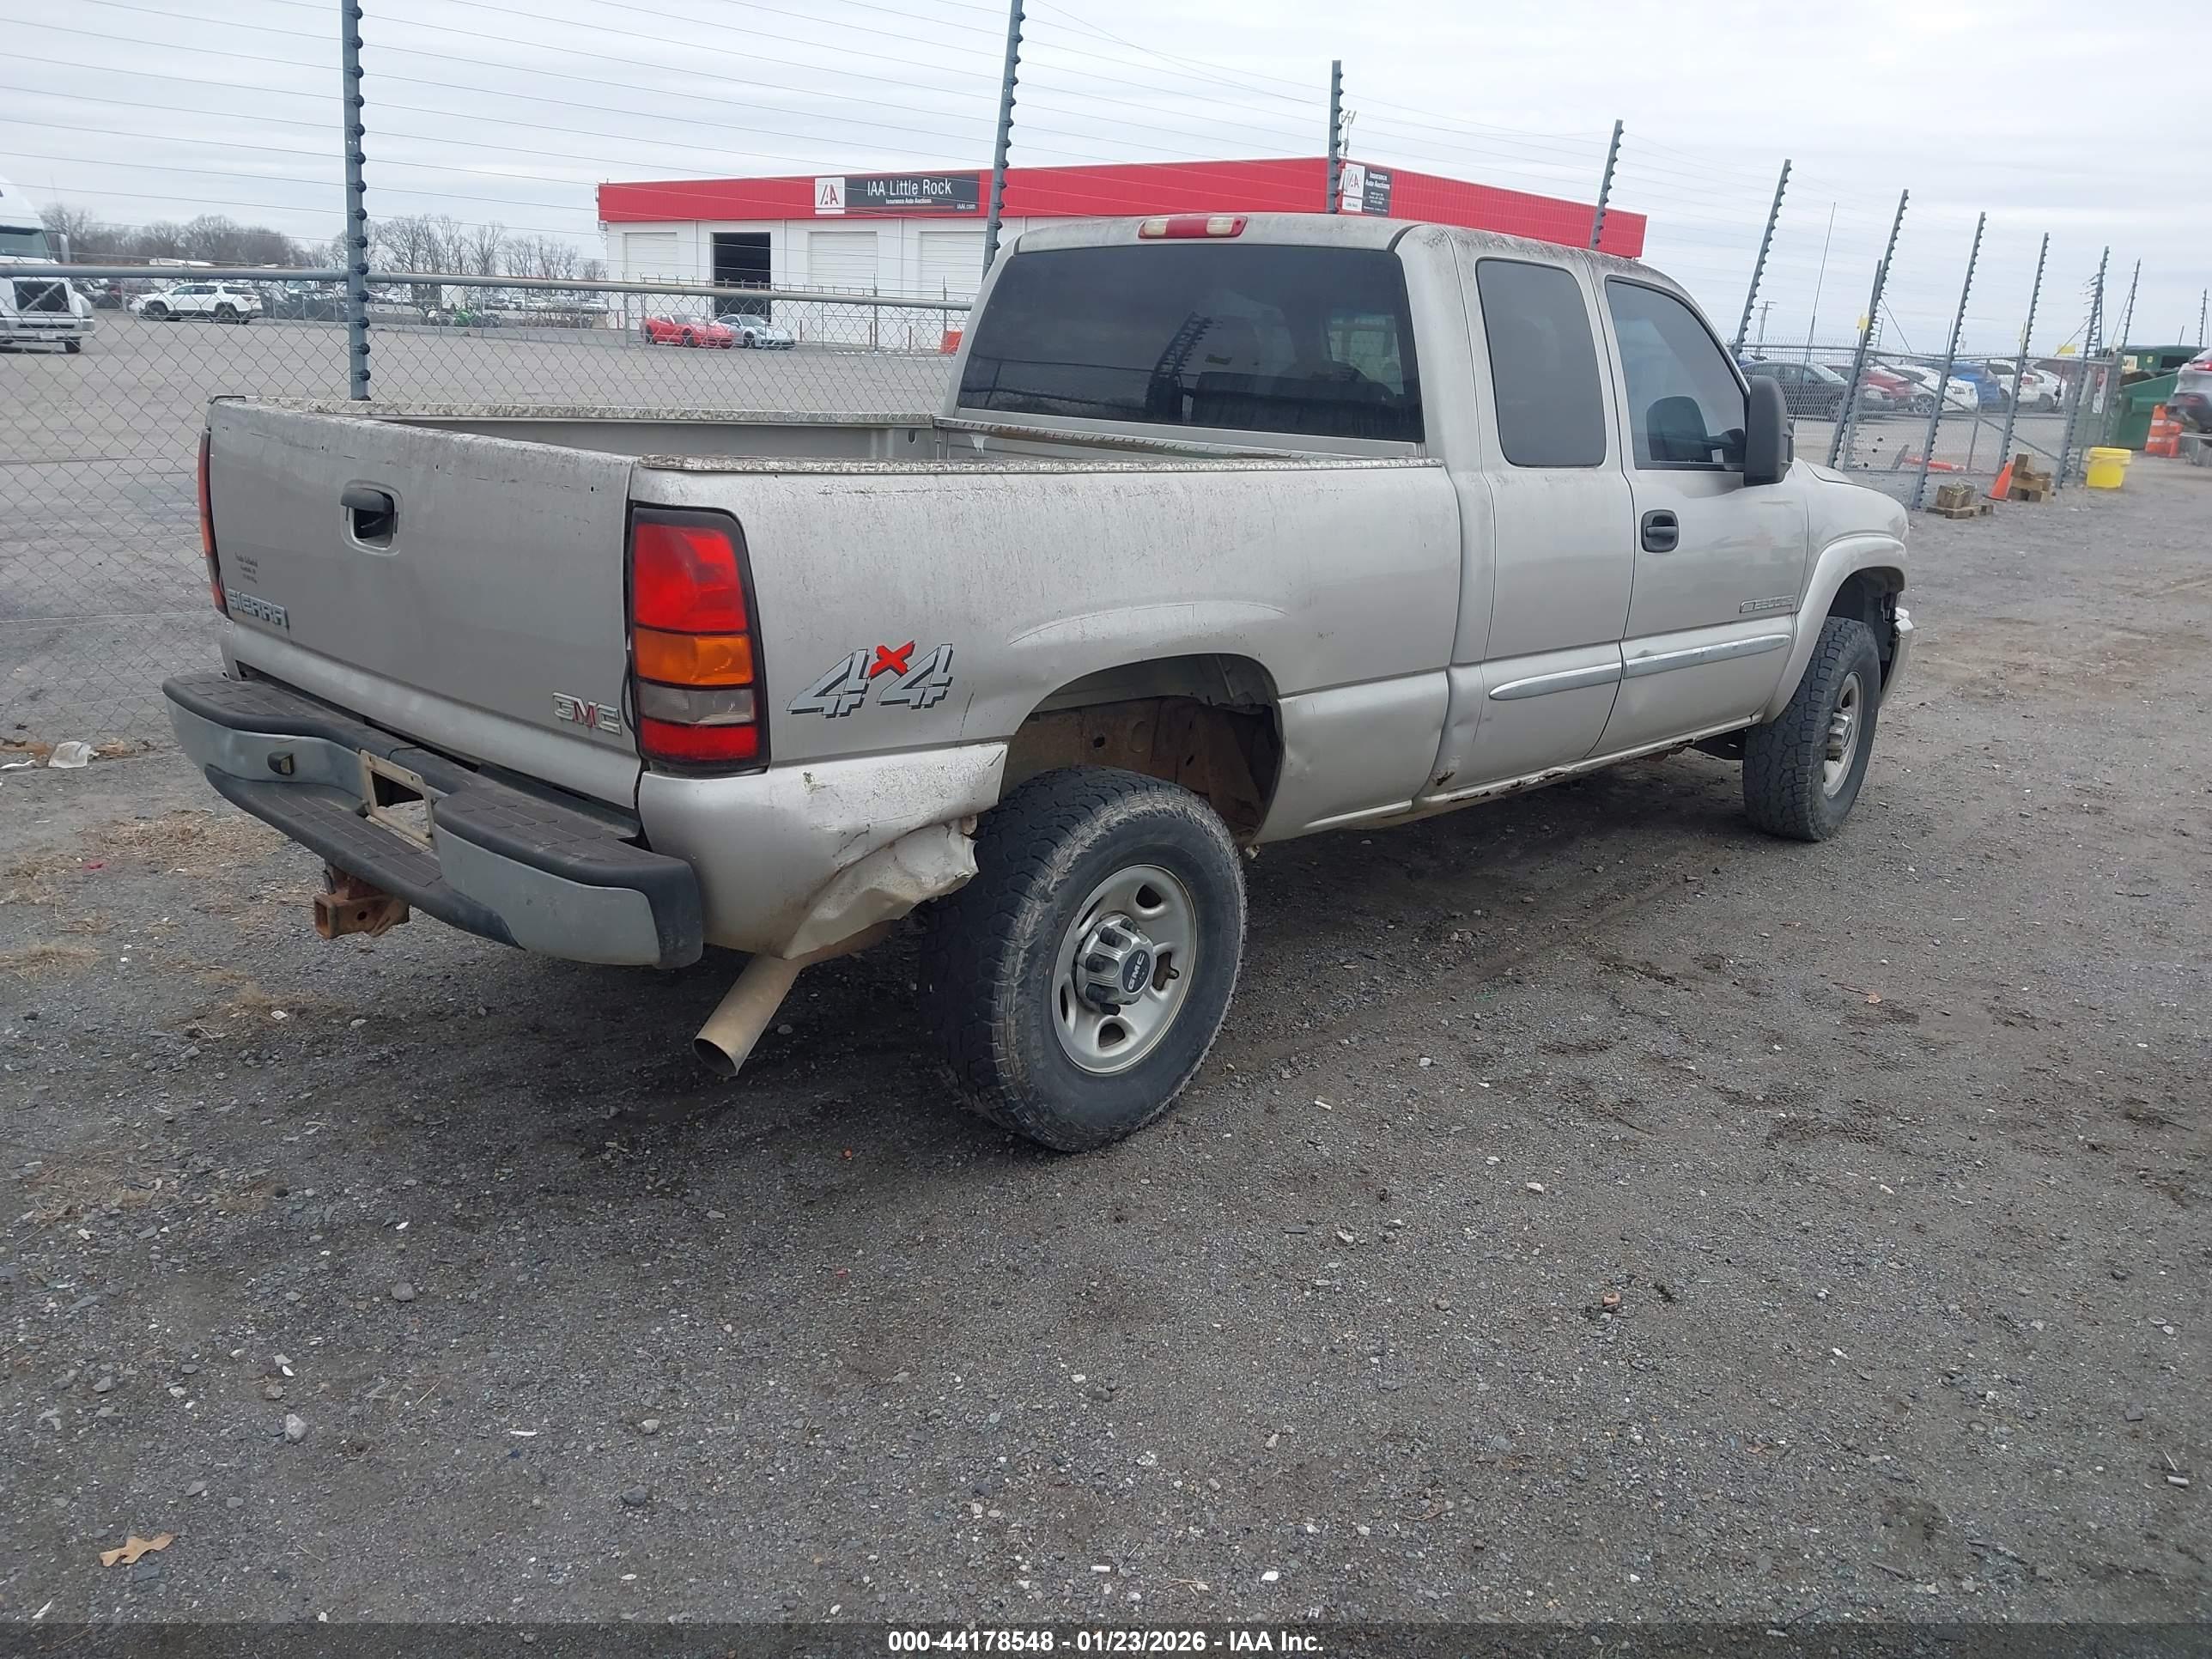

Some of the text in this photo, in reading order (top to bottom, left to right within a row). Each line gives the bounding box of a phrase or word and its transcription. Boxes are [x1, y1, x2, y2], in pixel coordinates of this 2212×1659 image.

[867, 178, 952, 197] IAA Little Rock
[227, 588, 289, 629] SIERRA
[552, 691, 623, 736] GMC
[1127, 953, 1146, 990] GMC
